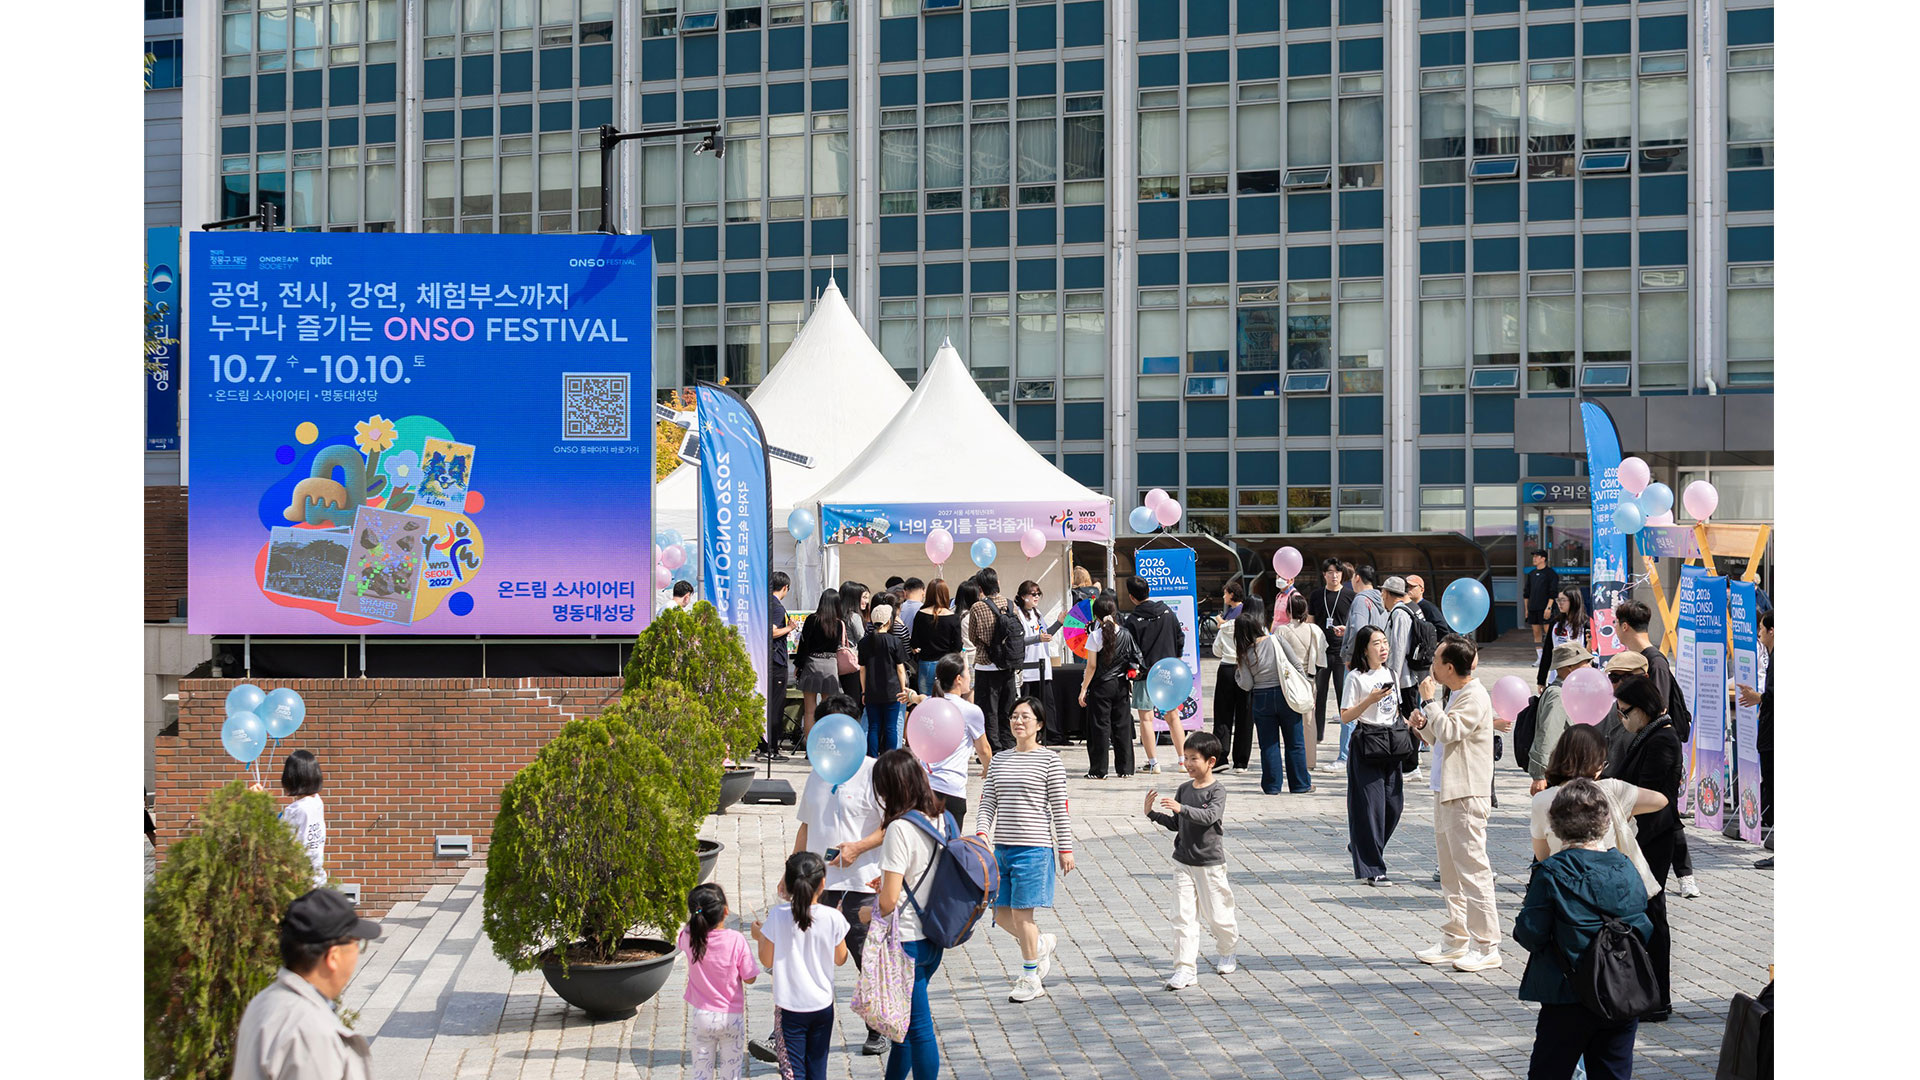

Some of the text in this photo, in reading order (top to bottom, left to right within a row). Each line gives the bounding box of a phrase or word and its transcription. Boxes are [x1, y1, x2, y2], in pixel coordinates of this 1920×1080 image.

[310, 254, 333, 268] cpbc
[569, 258, 605, 268] ONSO
[209, 281, 569, 313] 공연, 전시, 강연, 체험부스까지
[209, 314, 629, 343] 누구나 즐기는 ONSO FESTIVAL
[208, 354, 283, 383] 10.7.
[286, 355, 300, 368] 수
[413, 355, 427, 367] 토
[215, 390, 379, 402] 온드림 소사이어티 명동대성당
[553, 446, 640, 454] ONSO 홈페이지 바로가기
[1550, 485, 1591, 499] 우리은
[426, 496, 446, 507] Lion
[899, 519, 927, 535] 너의
[429, 561, 450, 570] WYD
[1139, 558, 1165, 567] 2026
[424, 569, 455, 579] SEOUL
[1139, 567, 1171, 577] ONSO
[428, 578, 453, 588] 2027
[1145, 576, 1188, 586] ESTIVAL
[1682, 576, 1694, 589] 2026
[497, 581, 635, 599] 온드림 소사이어티
[1680, 589, 1696, 602] ONSO
[1695, 588, 1711, 600] 2026
[359, 598, 398, 611] SHARED
[1731, 593, 1744, 606] 2026
[359, 606, 395, 619] WORLD
[552, 604, 636, 622] 명동대성당
[1695, 602, 1714, 613] ONSO
[1731, 607, 1746, 619] ONSO
[1695, 615, 1722, 627] FESTIVAL
[1732, 620, 1753, 634] FESTIVAL
